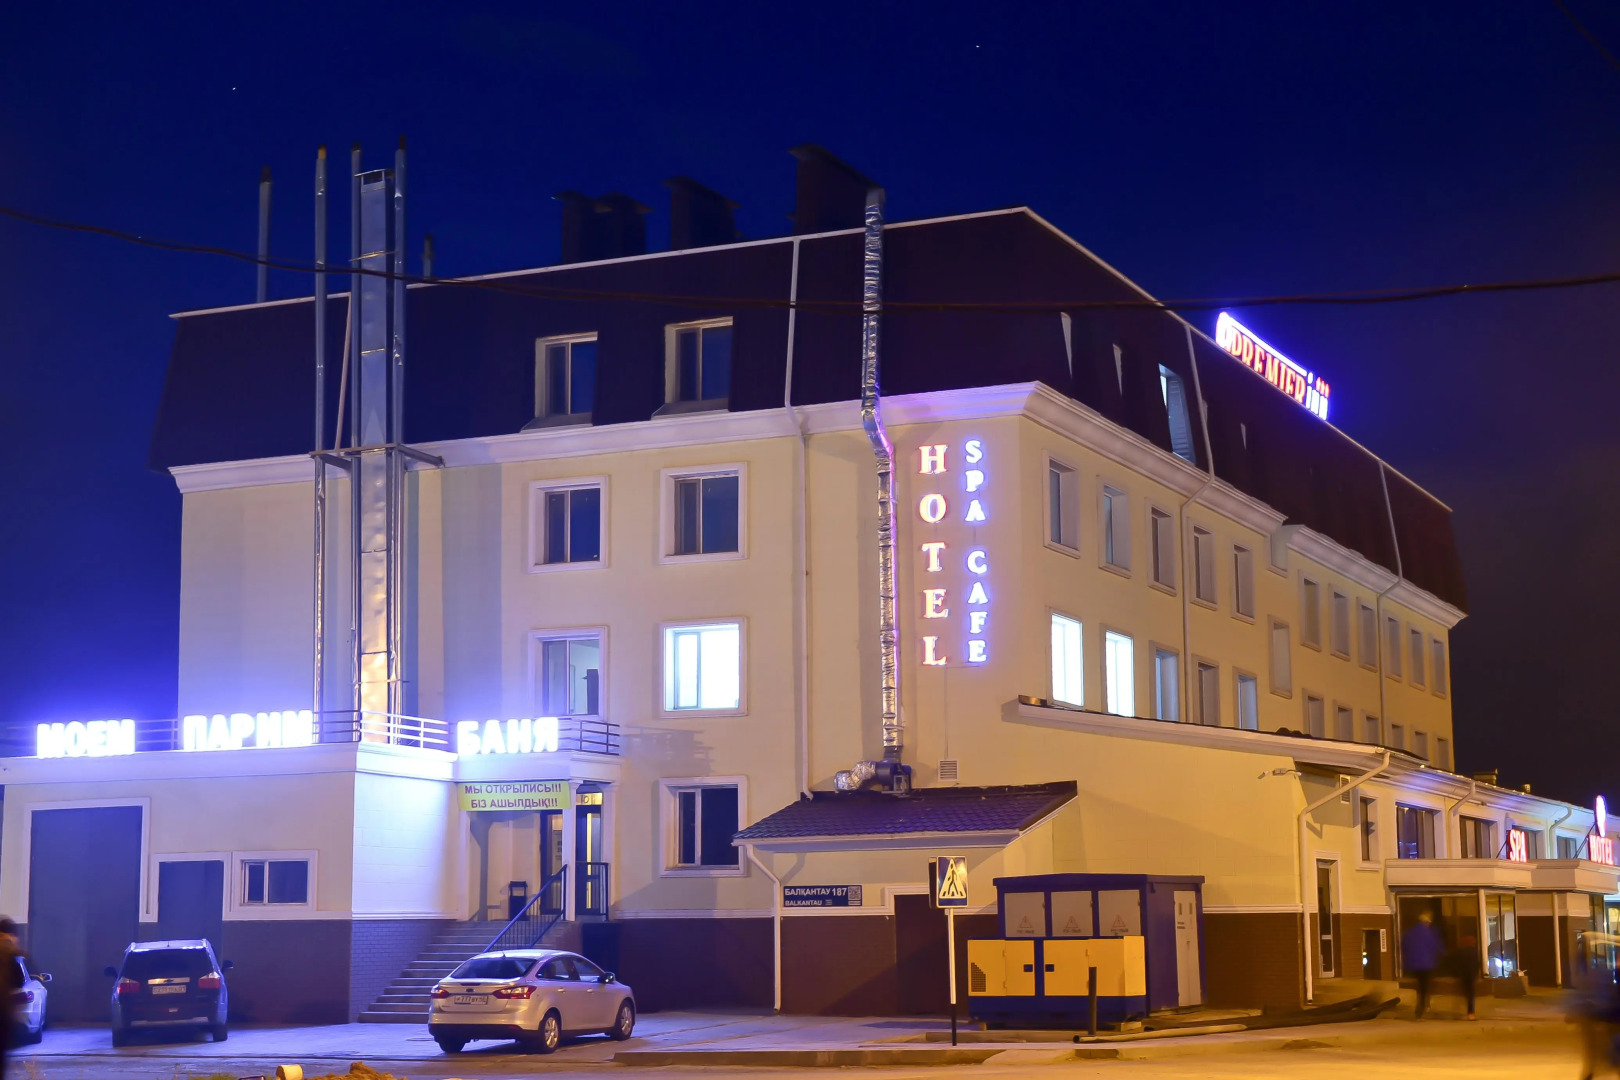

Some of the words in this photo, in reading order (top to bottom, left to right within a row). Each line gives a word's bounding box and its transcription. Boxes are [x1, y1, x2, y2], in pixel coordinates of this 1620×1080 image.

[964, 439, 986, 522] SPA
[918, 444, 948, 666] HOTEL
[967, 550, 988, 663] CAFE
[36, 718, 136, 759] МОЕМ
[183, 709, 313, 751] ПАРИМ
[457, 716, 559, 756] БАНЯ
[464, 785, 483, 794] МЫ
[485, 783, 562, 794] ОТКРЫЛИСЬ!!!
[470, 799, 487, 808] БІЗ
[1509, 828, 1527, 863] SPA
[1588, 833, 1614, 866] HOTEL
[784, 888, 831, 896] БАЛҚАНТАУ
[832, 887, 847, 896] 187
